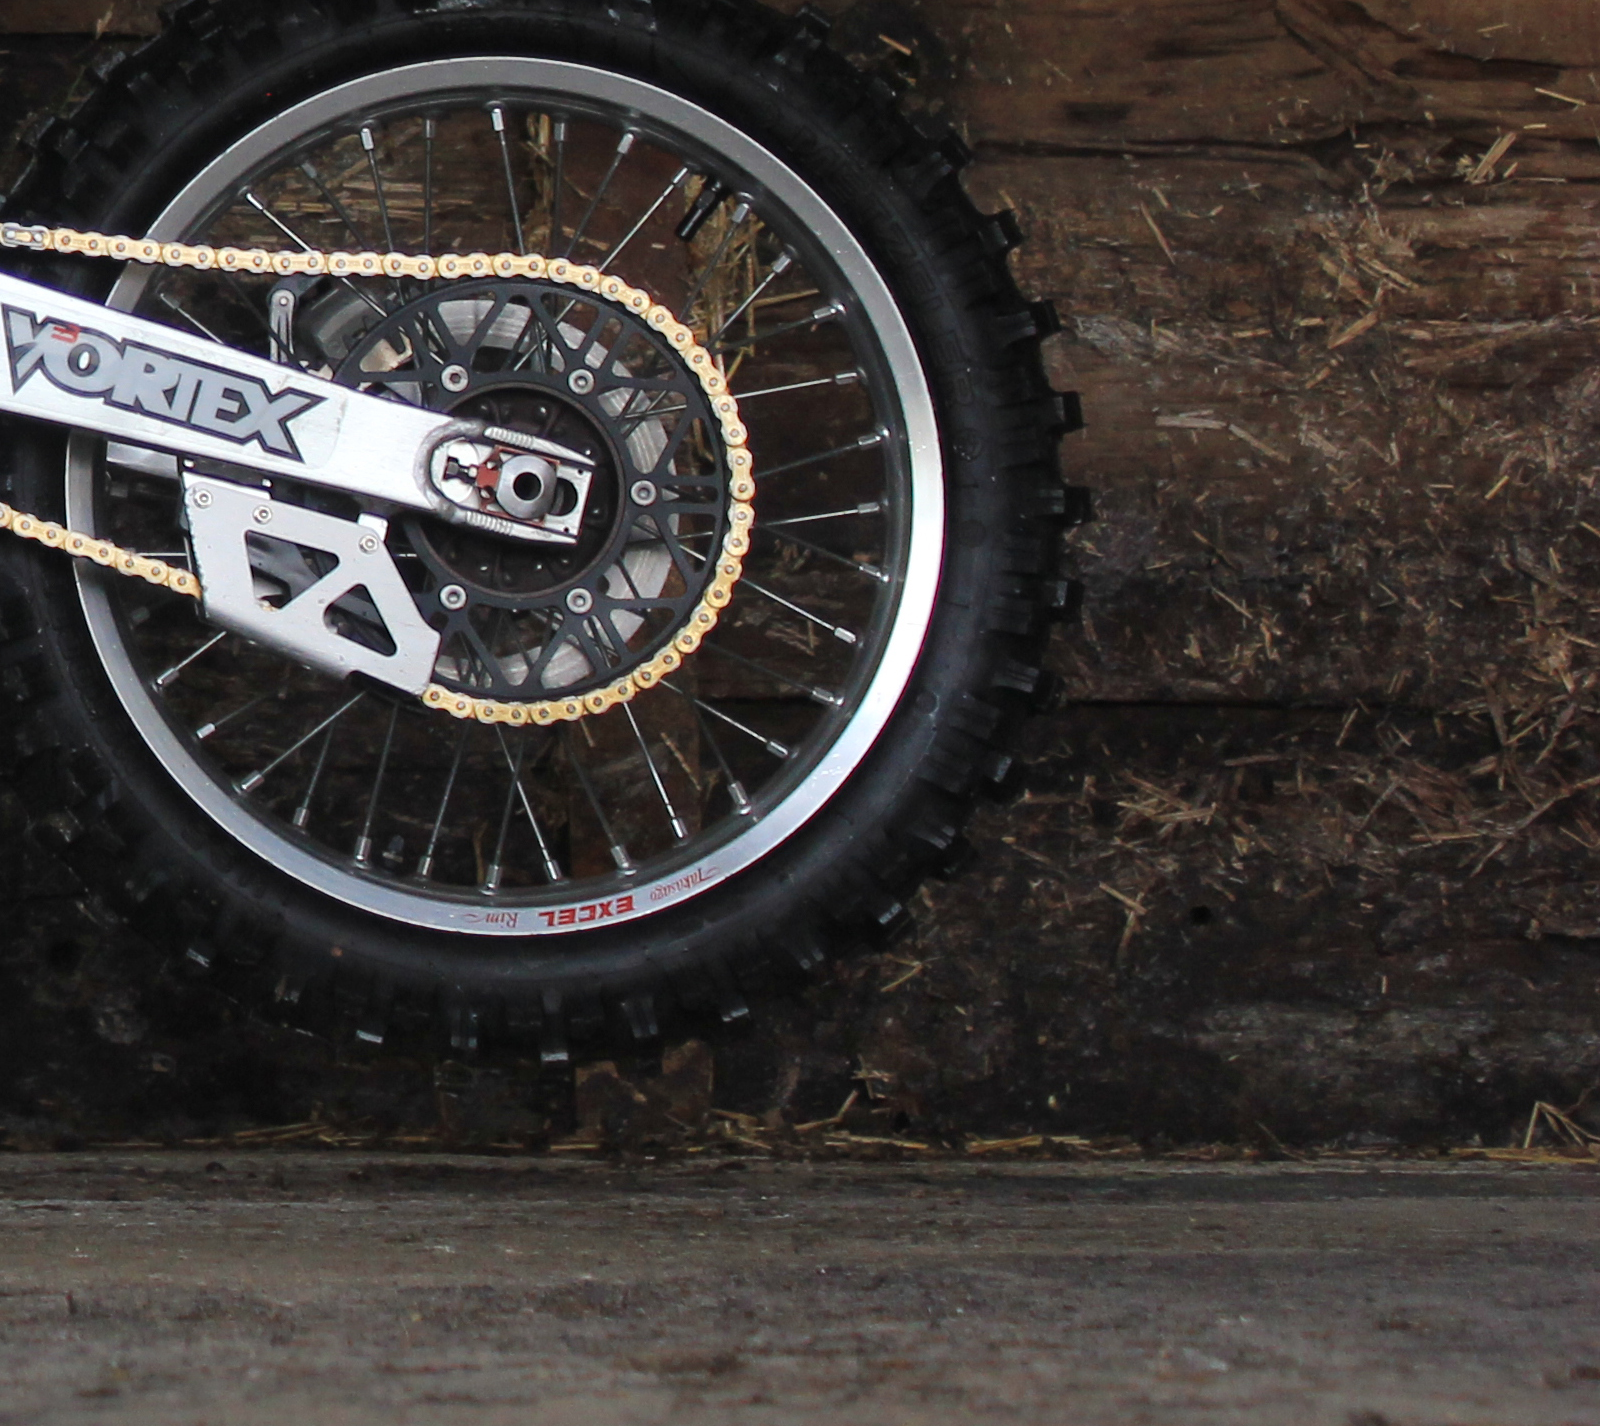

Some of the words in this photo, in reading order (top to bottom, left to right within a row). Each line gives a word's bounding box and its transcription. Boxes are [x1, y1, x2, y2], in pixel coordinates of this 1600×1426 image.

[1, 302, 328, 464] VORTEX
[483, 911, 519, 928] Rim
[539, 895, 636, 928] EXCEL
